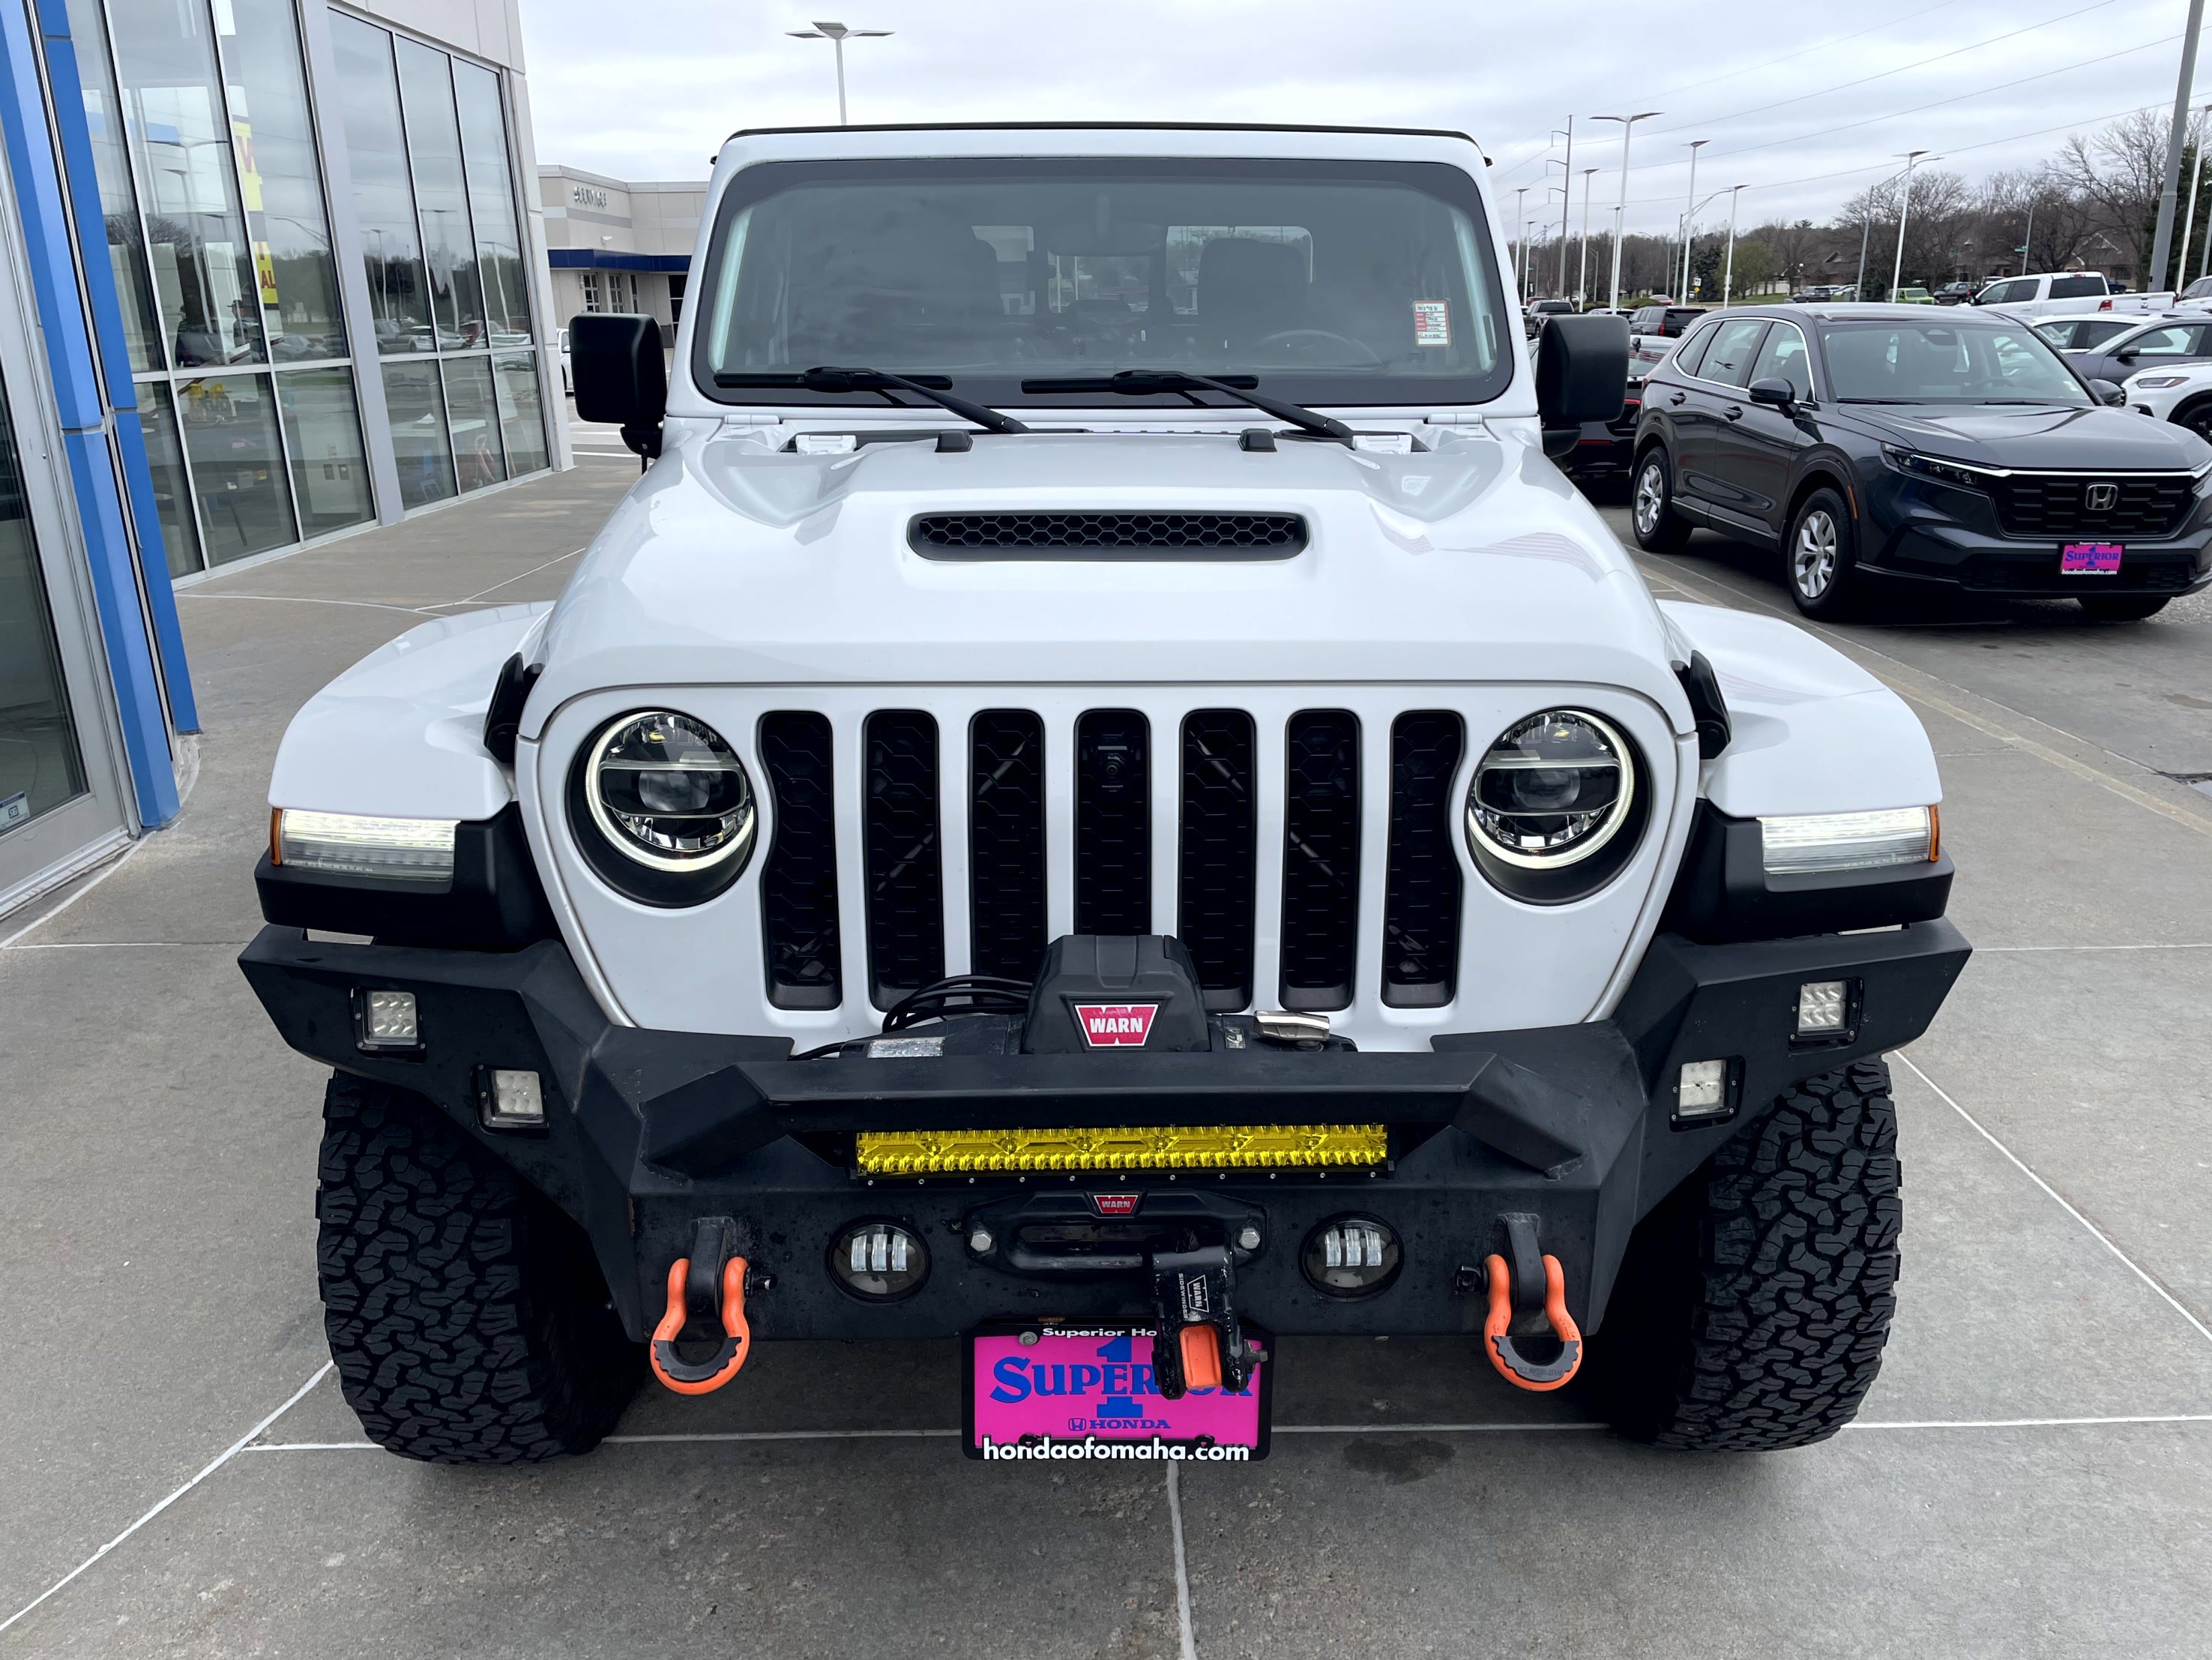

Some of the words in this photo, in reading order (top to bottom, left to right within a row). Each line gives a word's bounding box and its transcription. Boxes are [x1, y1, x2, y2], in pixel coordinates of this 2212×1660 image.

[1089, 1017, 1143, 1033] WARN
[1178, 1273, 1189, 1320] SIDEWINDER
[1193, 1282, 1203, 1308] WARN
[1043, 1328, 1126, 1338] Superior
[989, 1356, 1253, 1404] SUPER
[1088, 1419, 1172, 1429] HONDA
[983, 1436, 1250, 1461] hondaofomaha.com
